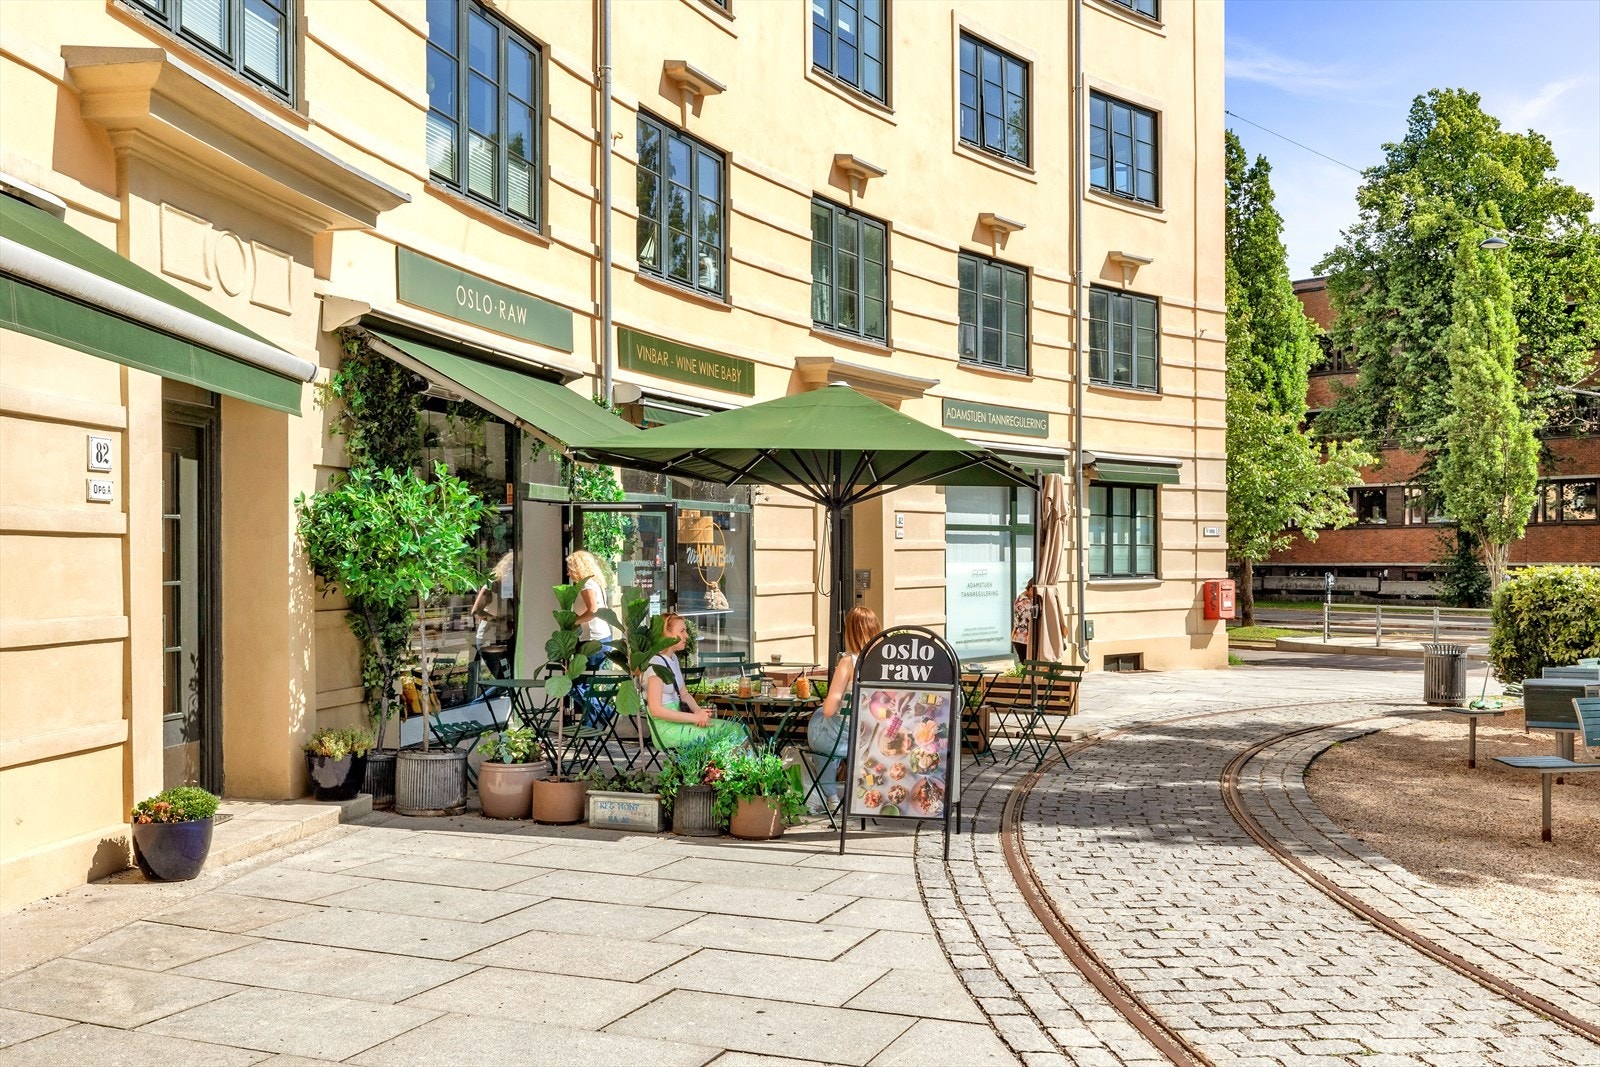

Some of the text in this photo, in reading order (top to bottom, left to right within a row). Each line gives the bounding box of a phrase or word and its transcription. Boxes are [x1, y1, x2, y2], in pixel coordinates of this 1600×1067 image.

[636, 344, 668, 367] VINBAR
[676, 355, 697, 374] WINE
[698, 361, 719, 379] WINE
[721, 366, 742, 383] BABY
[946, 407, 1047, 430] ADAMSTUEN TANNREGULERING
[96, 442, 109, 464] 82
[961, 590, 999, 598] TANNREGULERING
[881, 638, 935, 661] oslo
[880, 663, 934, 681] raw
